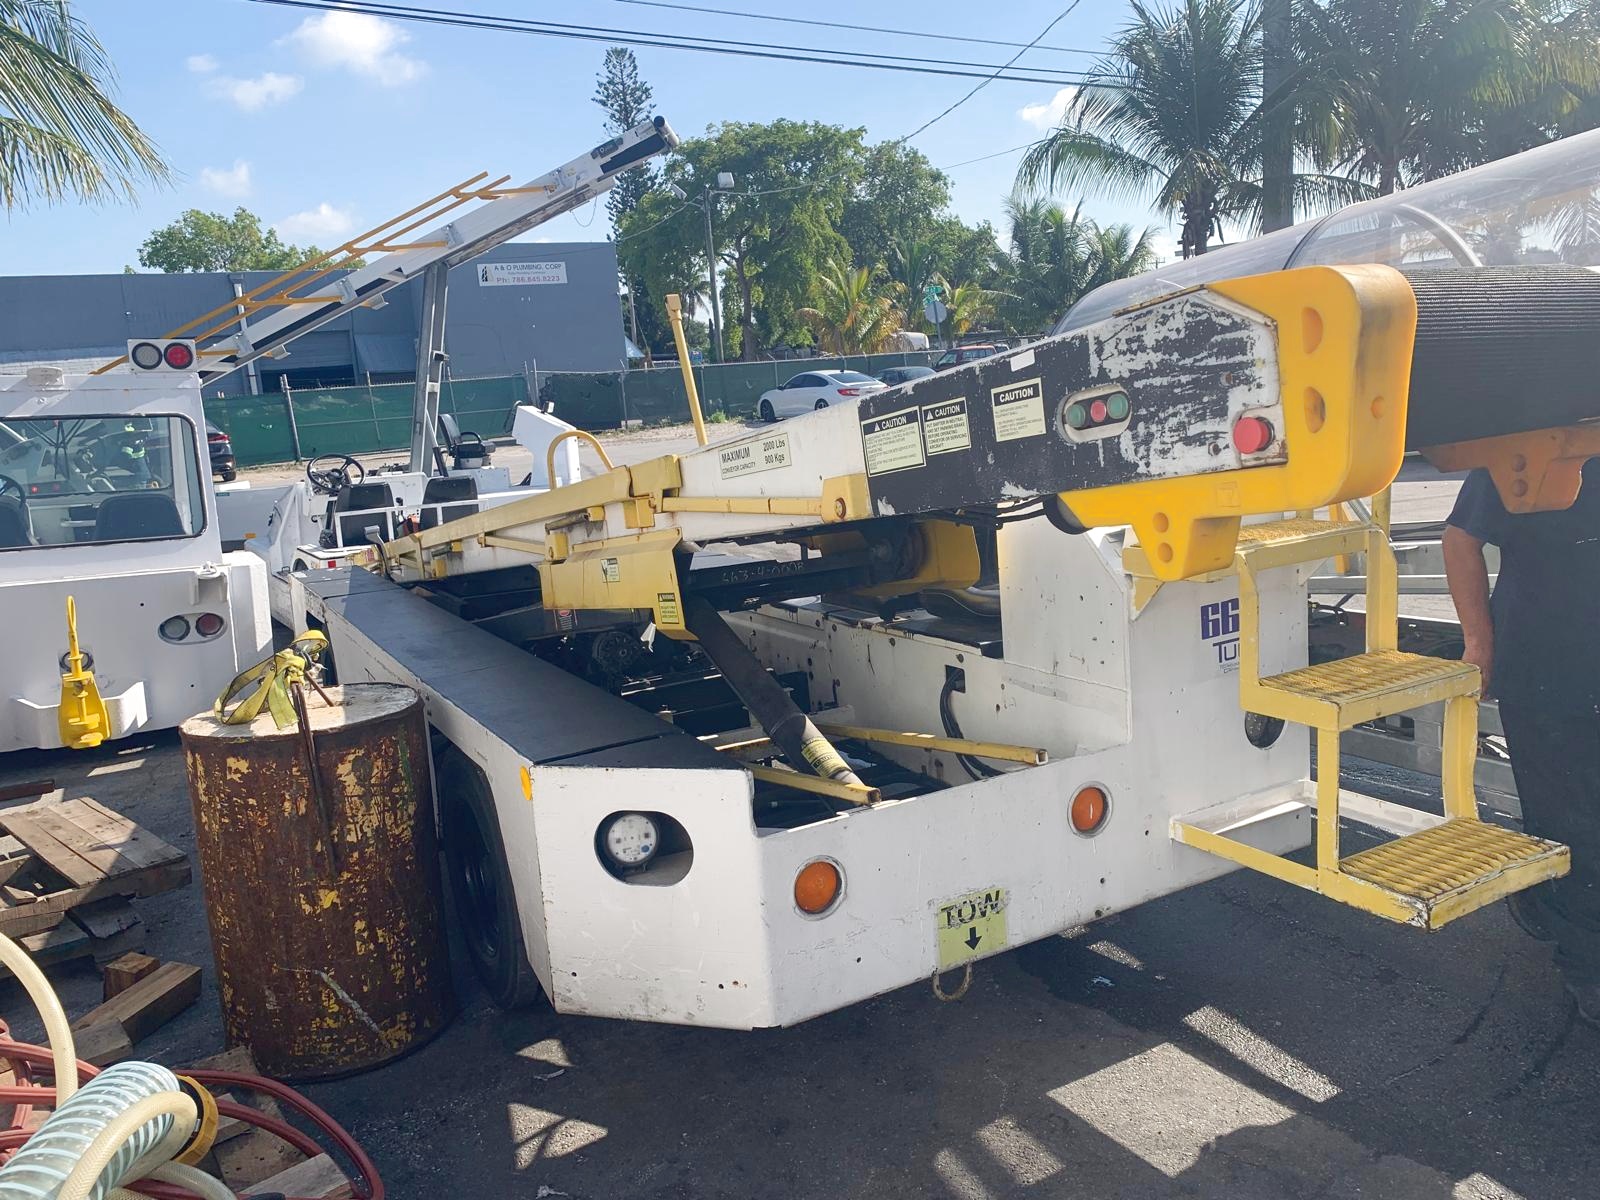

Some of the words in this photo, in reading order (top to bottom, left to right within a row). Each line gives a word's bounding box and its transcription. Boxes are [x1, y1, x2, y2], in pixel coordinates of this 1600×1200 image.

[999, 387, 1034, 403] CAUTION
[935, 405, 960, 417] CAUTION
[881, 416, 907, 430] CAUTION
[763, 440, 775, 452] 2000
[775, 439, 786, 449] Lbs
[721, 447, 750, 464] MAXIMUM
[764, 454, 774, 465] 900
[774, 452, 785, 464] Kgs
[722, 464, 740, 474] CONVEYOR
[740, 461, 756, 471] CAPACITY
[1212, 637, 1241, 664] TU
[940, 889, 1000, 929] TOW
